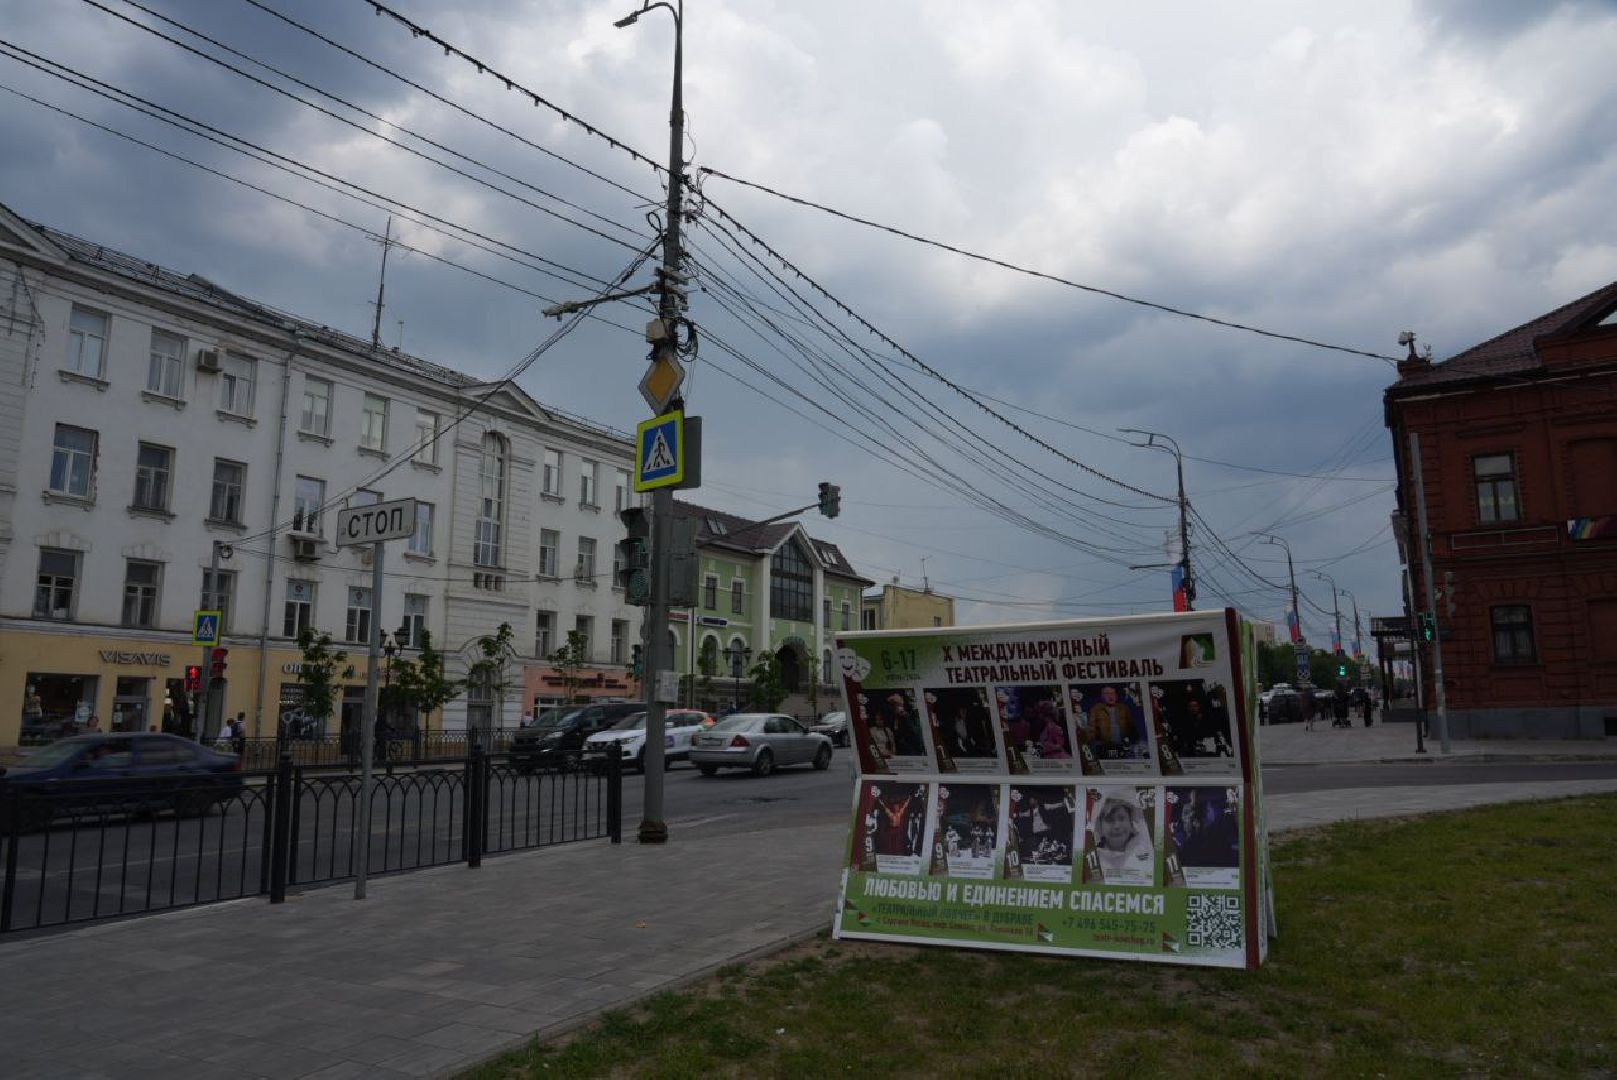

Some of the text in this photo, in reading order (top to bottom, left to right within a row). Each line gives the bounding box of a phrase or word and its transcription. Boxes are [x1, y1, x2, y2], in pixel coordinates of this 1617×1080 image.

[348, 506, 403, 538] СТОП
[957, 634, 1110, 661] МЕЖДУНАРОДНЫЙ
[946, 658, 1164, 684] ТЕАТРАЛЬНЫЙ ФЕСТИВАЛЬ
[864, 879, 1164, 915] ЛЮБОВЬЮ И ЕДИНЕНИЕМ СПАСЕМСЯ
